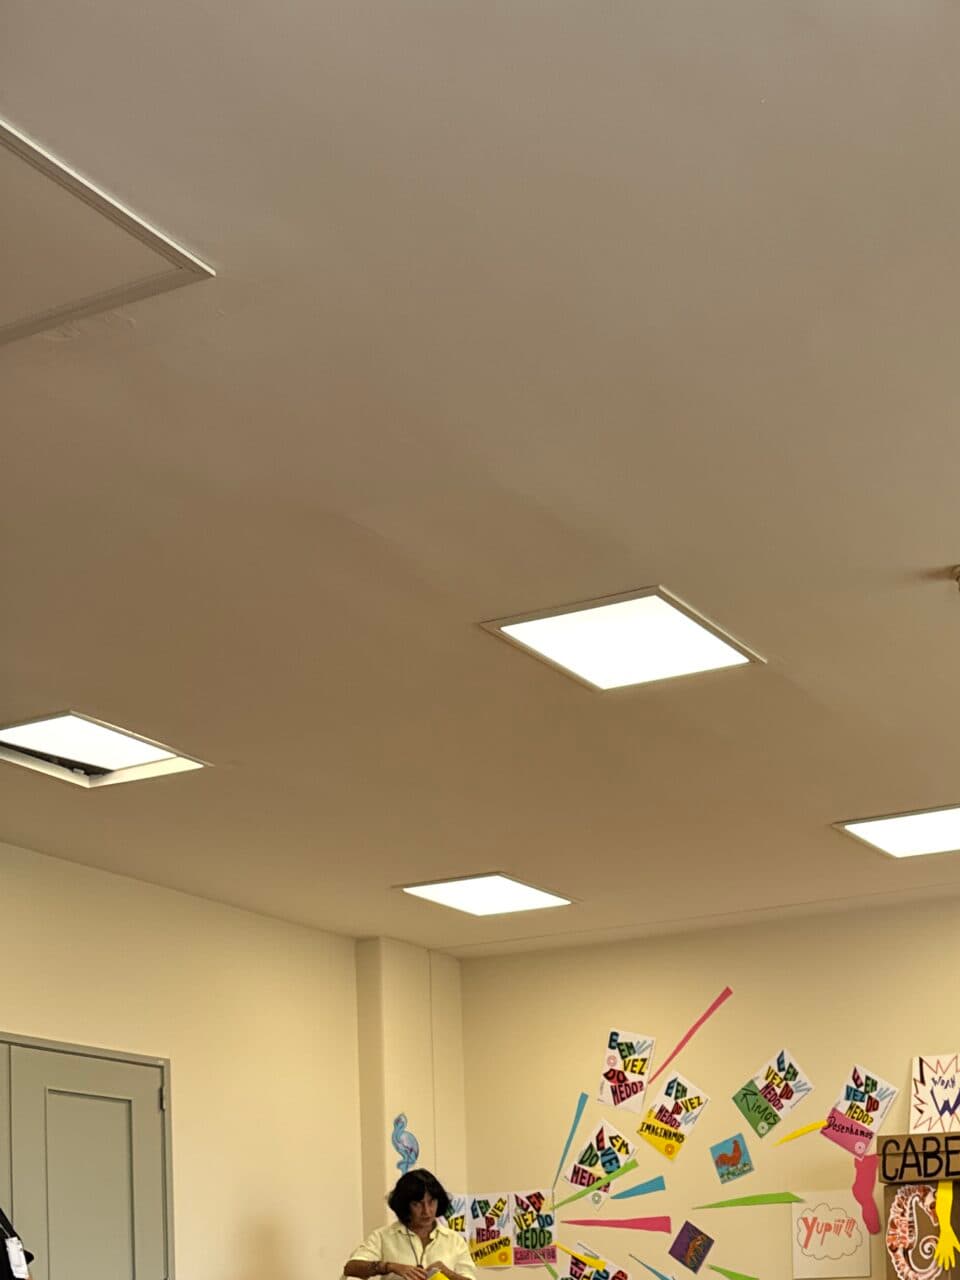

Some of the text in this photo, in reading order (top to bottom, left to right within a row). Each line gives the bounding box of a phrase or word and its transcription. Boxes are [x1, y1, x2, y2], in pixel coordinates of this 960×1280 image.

[617, 1042, 636, 1060] EM
[602, 1068, 628, 1084] DO
[623, 1058, 648, 1075] VEZ
[765, 1066, 794, 1100] VEZ DO
[864, 1074, 878, 1094] EM
[610, 1081, 644, 1106] MEDO?
[845, 1085, 880, 1113] VEZ DO
[680, 1096, 703, 1113] VEZ
[845, 1102, 874, 1126] MEDO?
[640, 1121, 685, 1144] IMAGINAMOS
[578, 1142, 599, 1167] DO
[609, 1135, 629, 1155] EM
[489, 1198, 507, 1218] VEZ
[447, 1215, 465, 1232] VEZ
[513, 1211, 553, 1231] VEZ DO
[476, 1228, 500, 1244] MEDO?
[516, 1228, 552, 1249] MEDO?
[471, 1236, 510, 1262] IMAGINAMOS
